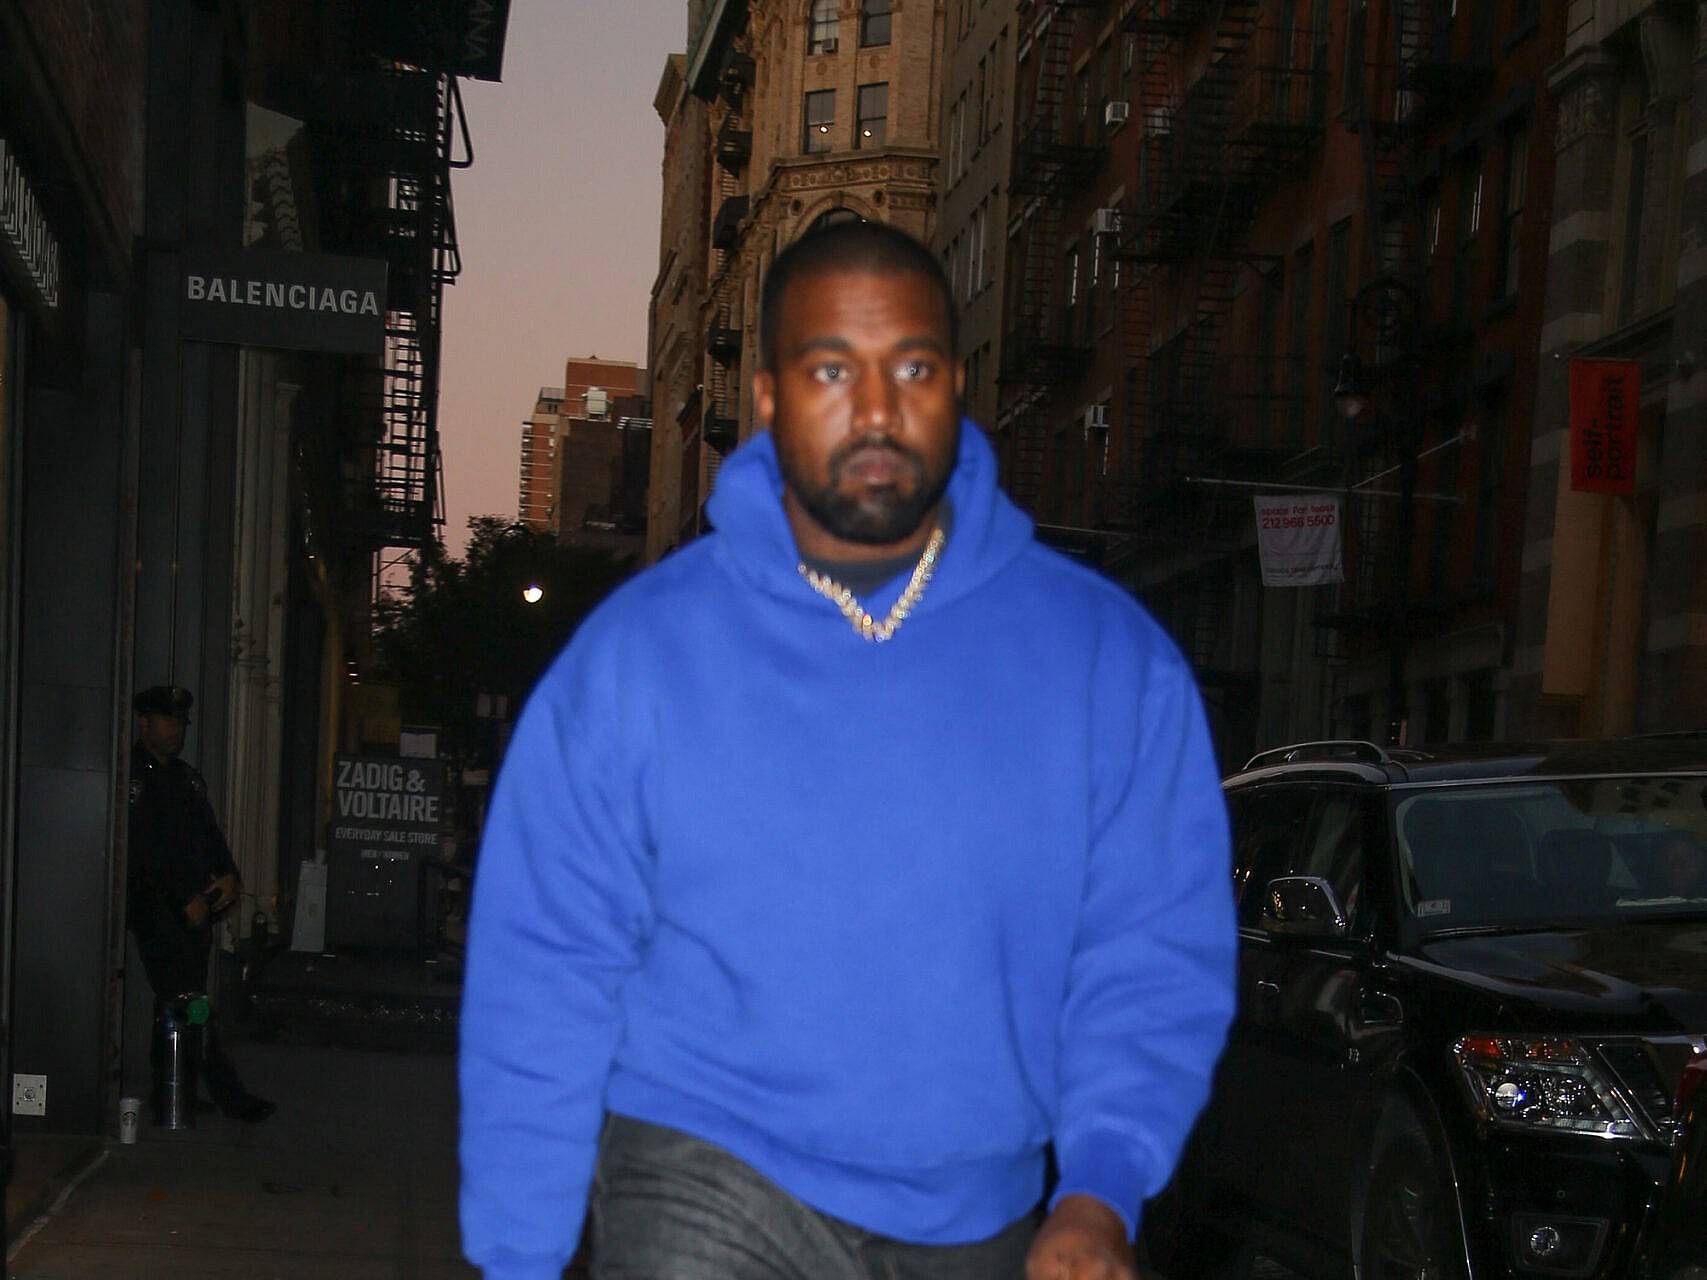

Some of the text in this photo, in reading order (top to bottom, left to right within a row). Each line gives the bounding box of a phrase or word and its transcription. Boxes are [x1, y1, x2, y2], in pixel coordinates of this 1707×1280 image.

[187, 275, 379, 316] BALENCIAGA
[1604, 374, 1625, 480] portrait
[1262, 517, 1281, 529] 212
[1282, 516, 1305, 528] 966
[337, 790, 440, 823] VOLTAIRE
[335, 827, 438, 845] EVERYDAY SALE STORE
